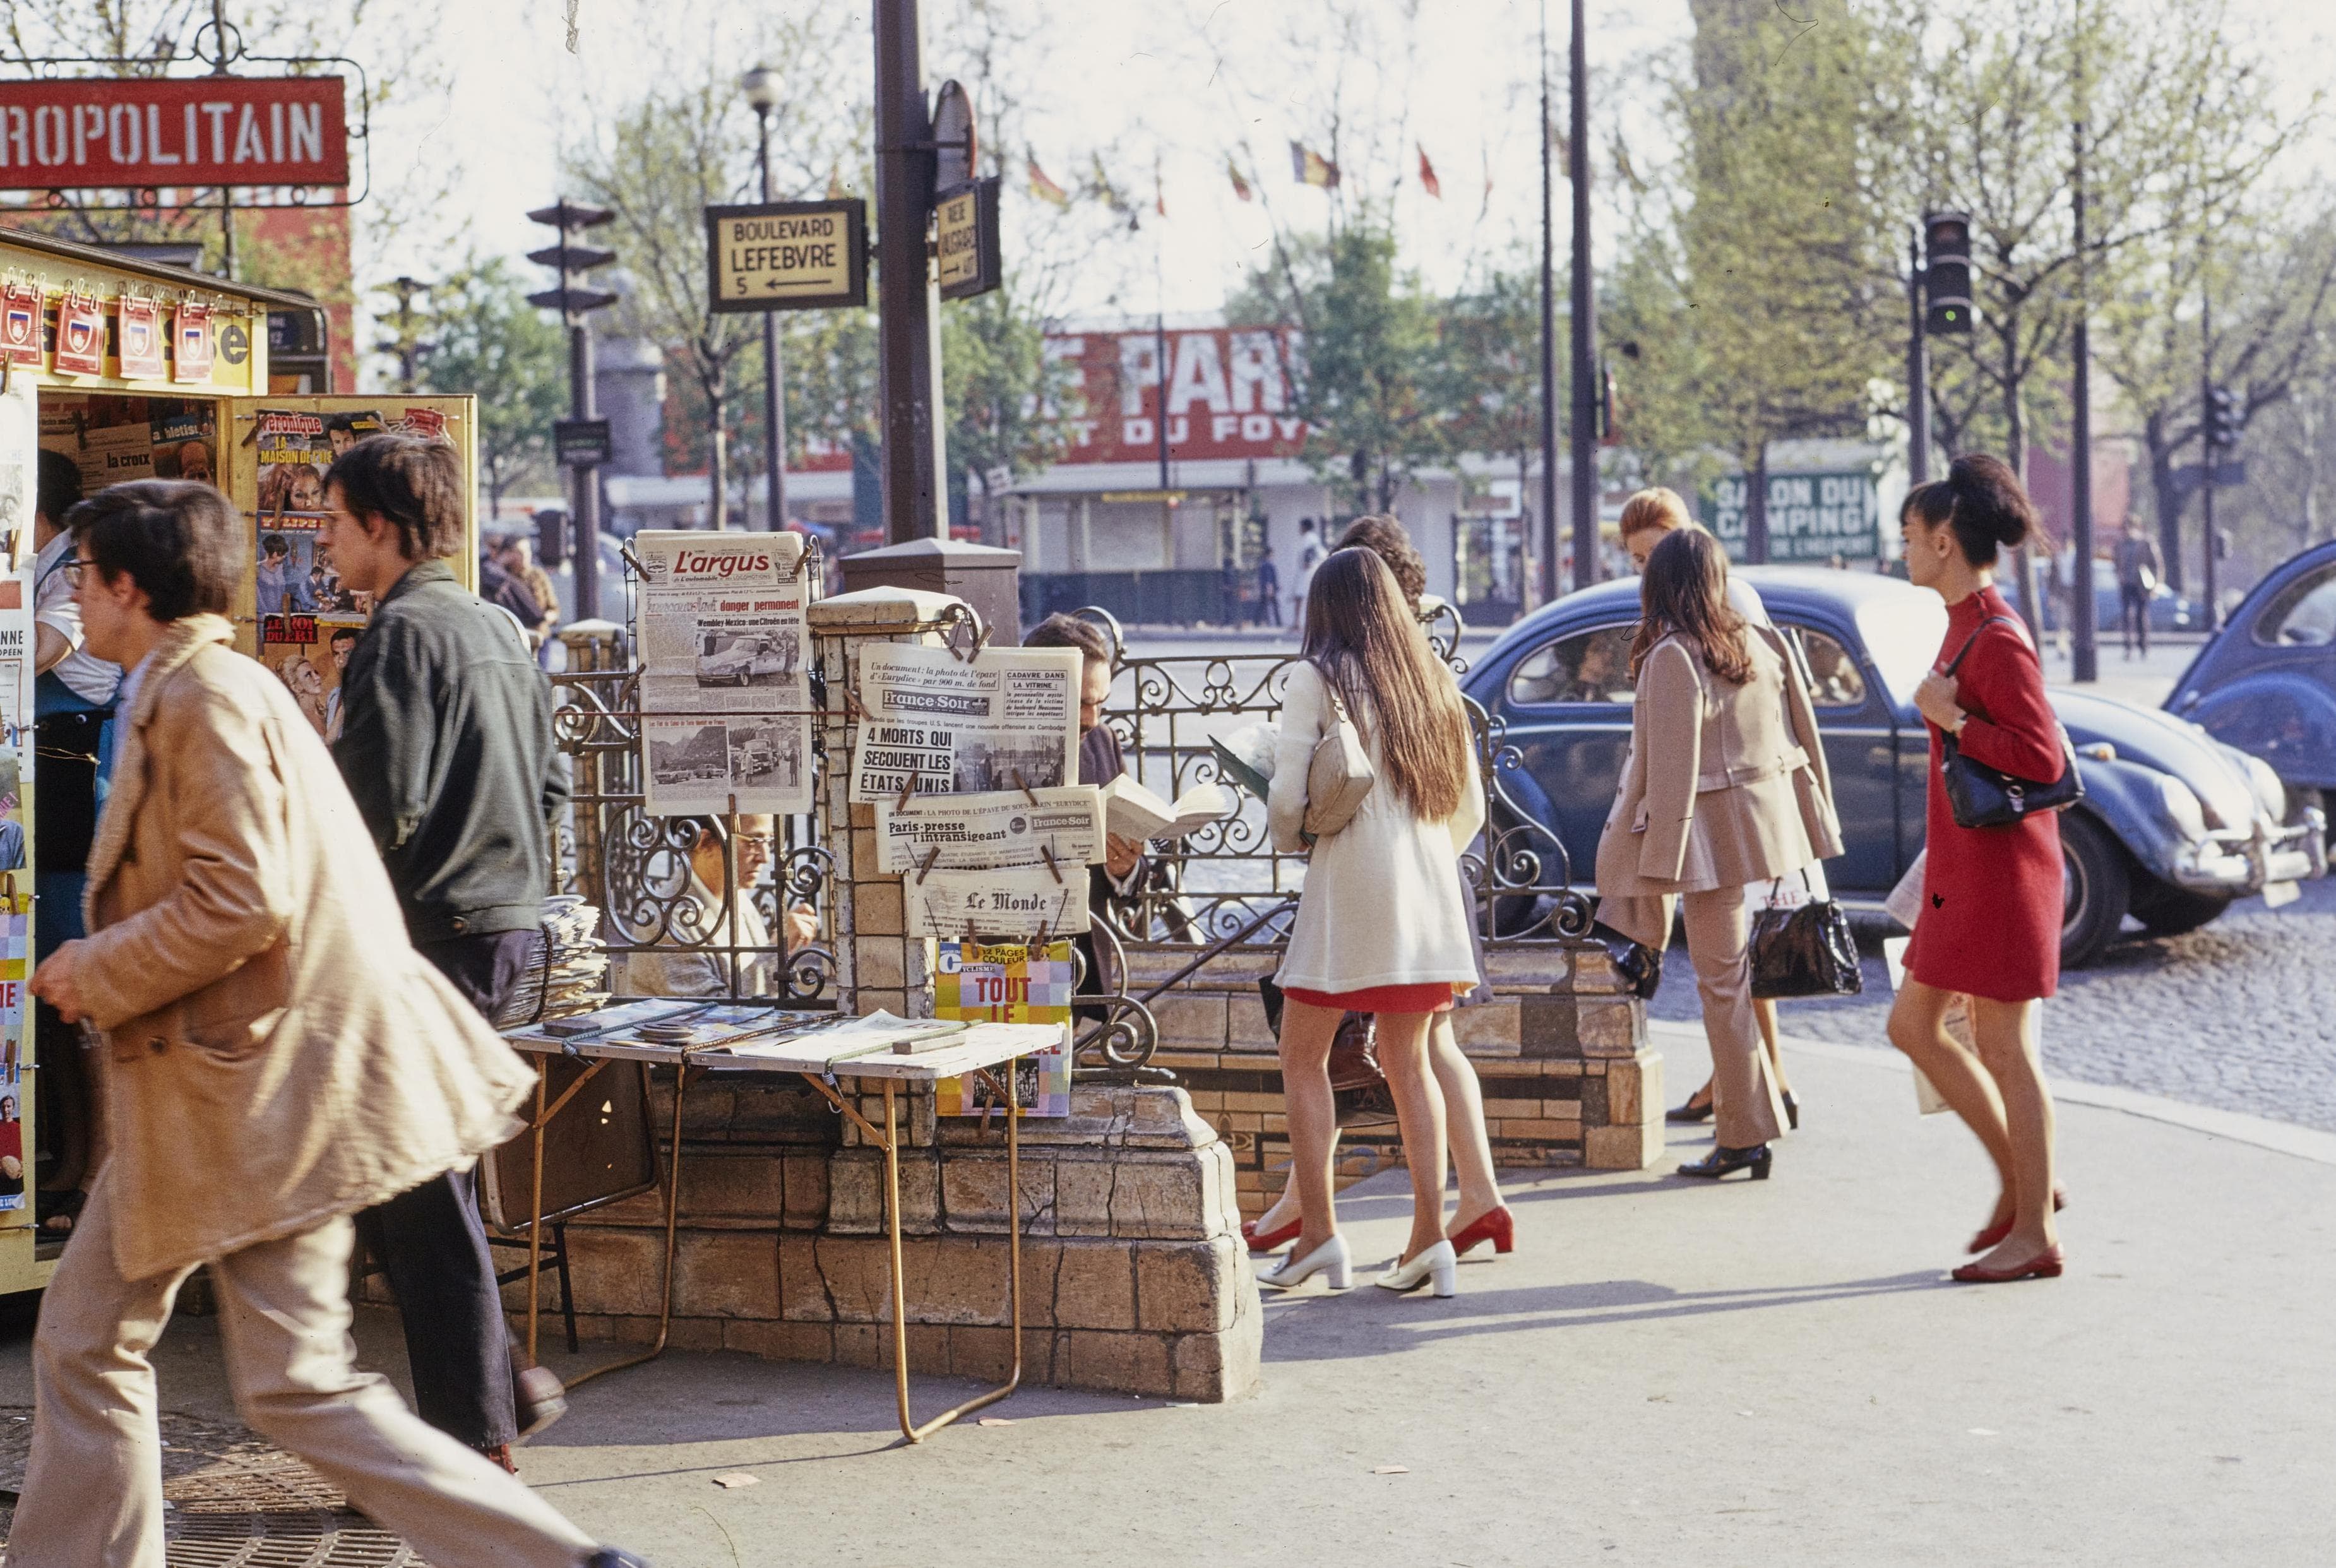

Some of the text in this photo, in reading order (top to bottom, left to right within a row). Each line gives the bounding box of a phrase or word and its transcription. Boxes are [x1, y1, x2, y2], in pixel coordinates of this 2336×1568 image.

[734, 219, 833, 242] BOULEVARD
[732, 244, 837, 272] LEFEBVRE
[107, 452, 151, 468] la croix
[260, 450, 298, 464] MAISON
[1715, 477, 1813, 508] SON
[1715, 506, 1862, 536] CMPING
[674, 551, 770, 577] L'argus
[720, 600, 750, 612] danger
[754, 598, 799, 612] permanent
[760, 617, 780, 626] Citroën
[934, 668, 958, 678] photo
[959, 669, 968, 677] de
[970, 669, 997, 679] l'épave
[978, 680, 996, 688] fond
[907, 718, 927, 727] troupes
[867, 727, 951, 747] 4 MORTS QUI
[864, 750, 951, 770] SECOUENT LES
[973, 806, 999, 815] L'ÉPAVE
[914, 829, 1006, 843] l'intransigeant
[963, 890, 1047, 910] Le Monde
[982, 955, 1025, 965] COULEUR
[996, 948, 1025, 957] PAGES
[975, 977, 1032, 1002] TOUT
